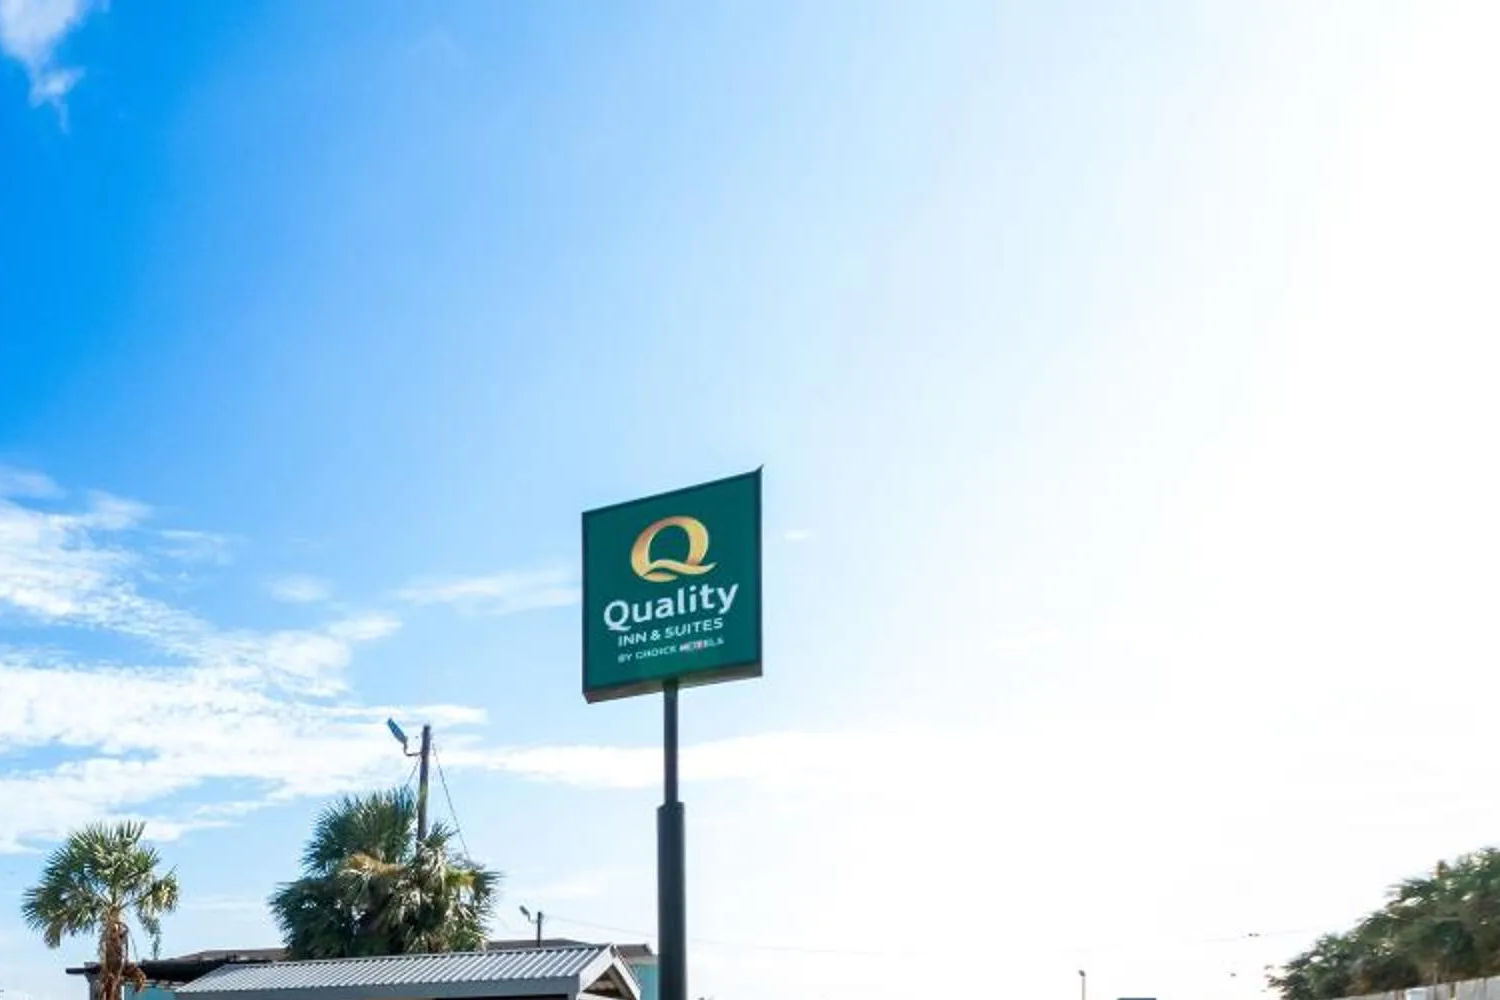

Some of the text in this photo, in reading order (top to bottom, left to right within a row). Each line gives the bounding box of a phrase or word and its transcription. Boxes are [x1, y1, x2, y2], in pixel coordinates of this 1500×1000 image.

[603, 583, 738, 631] Quality
[618, 618, 723, 647] INN & SUITES
